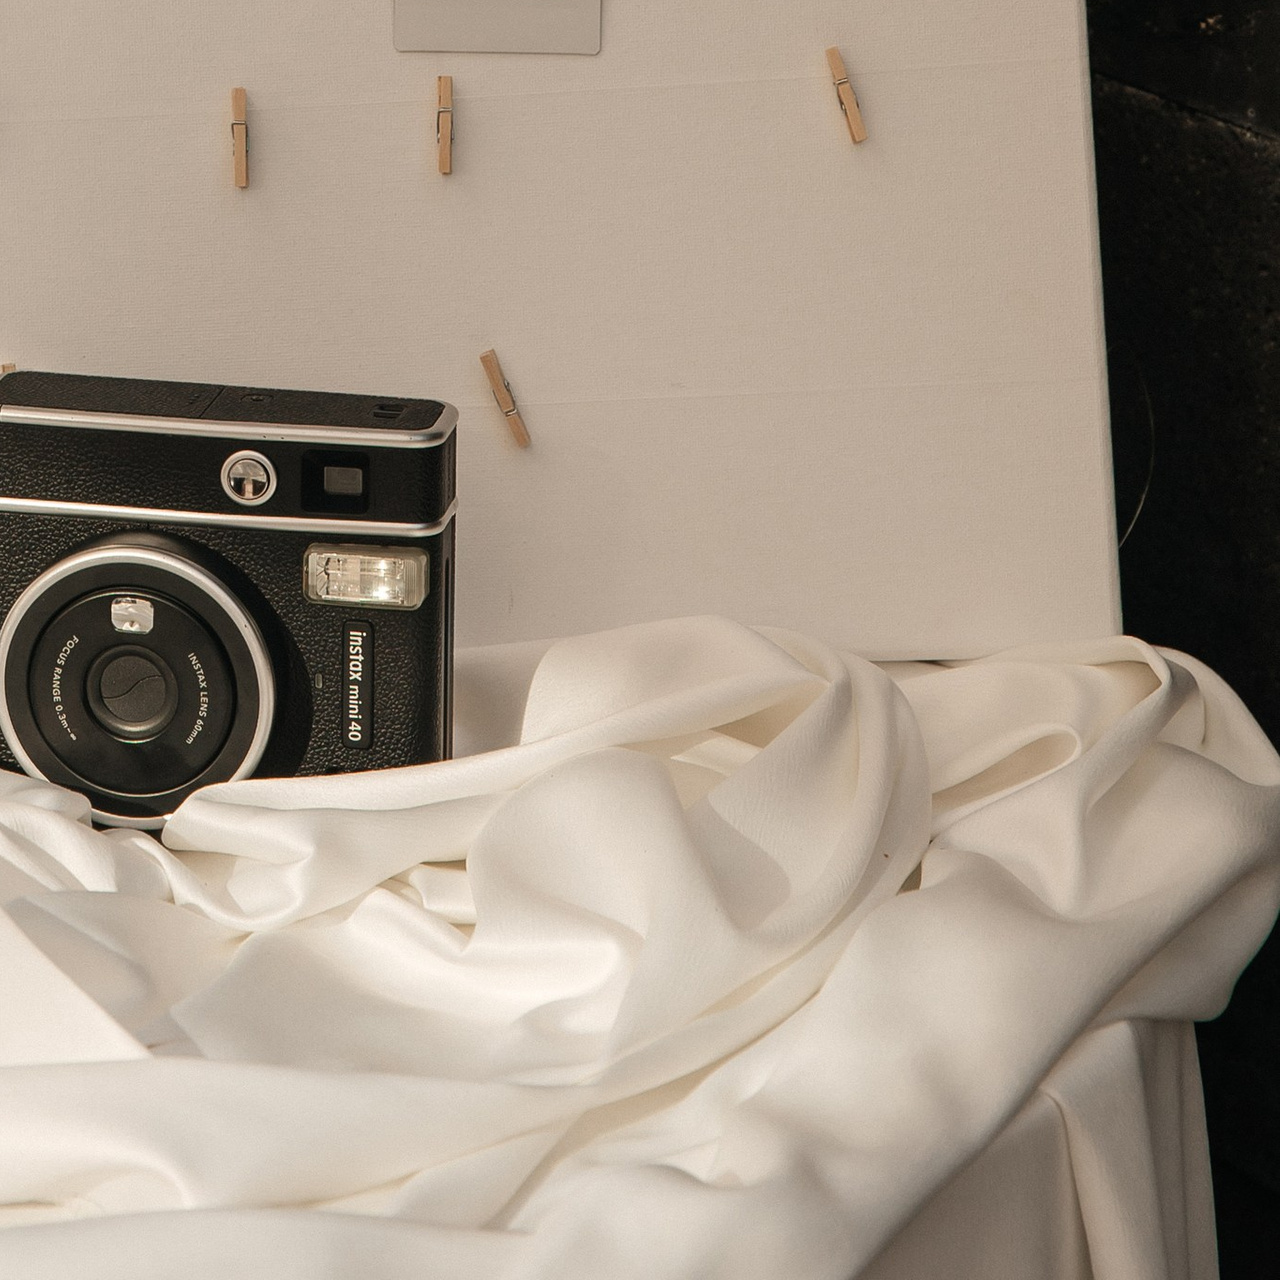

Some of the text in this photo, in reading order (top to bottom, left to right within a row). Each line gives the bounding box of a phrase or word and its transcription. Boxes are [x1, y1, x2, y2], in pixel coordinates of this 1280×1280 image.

[56, 635, 80, 666] FOCUS
[52, 666, 63, 702] RANGE
[185, 652, 209, 745] INSTAX LENS 60mm
[348, 630, 367, 742] instax mini 40
